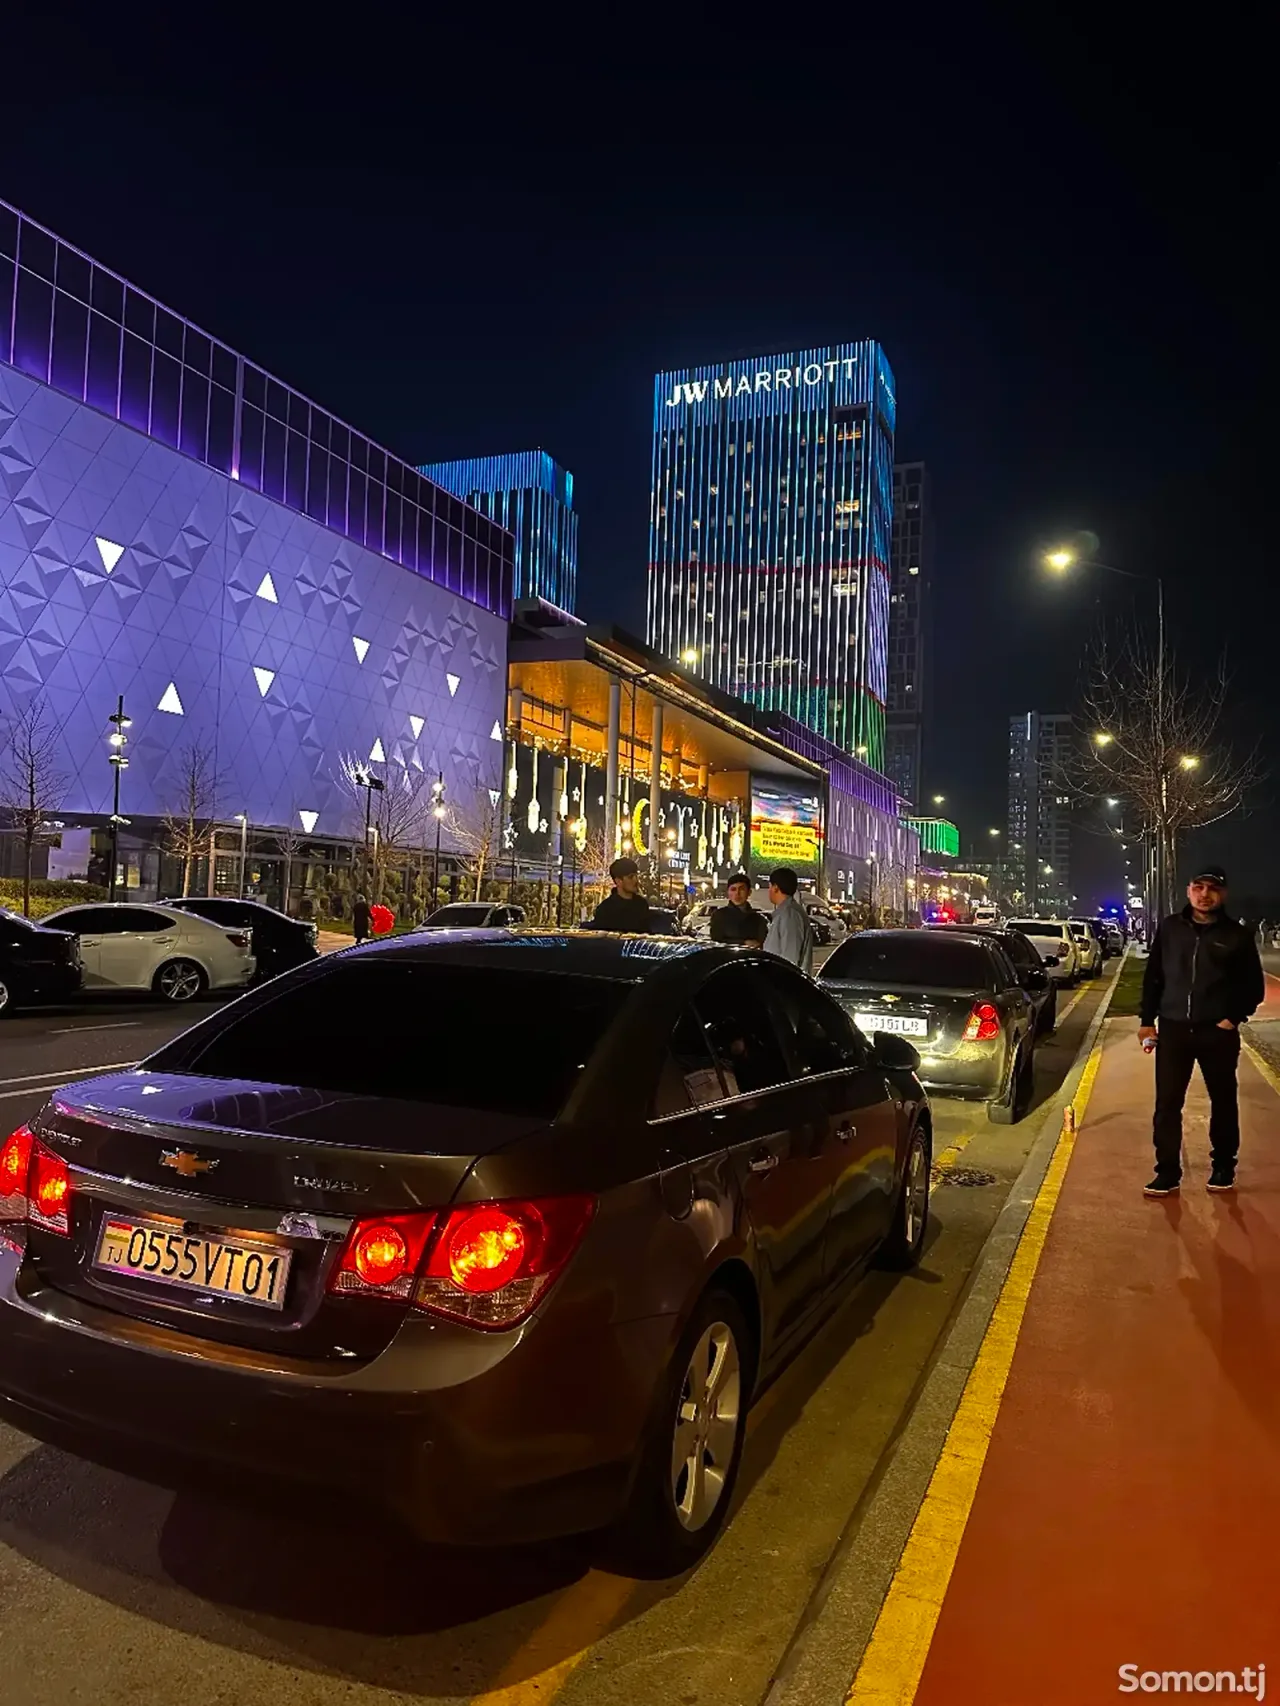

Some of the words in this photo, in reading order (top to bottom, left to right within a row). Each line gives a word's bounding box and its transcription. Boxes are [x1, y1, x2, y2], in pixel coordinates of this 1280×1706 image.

[666, 381, 709, 406] JW
[714, 358, 857, 399] MARRIOTT
[107, 1246, 123, 1264] TJ
[127, 1228, 281, 1300] 0555VT01
